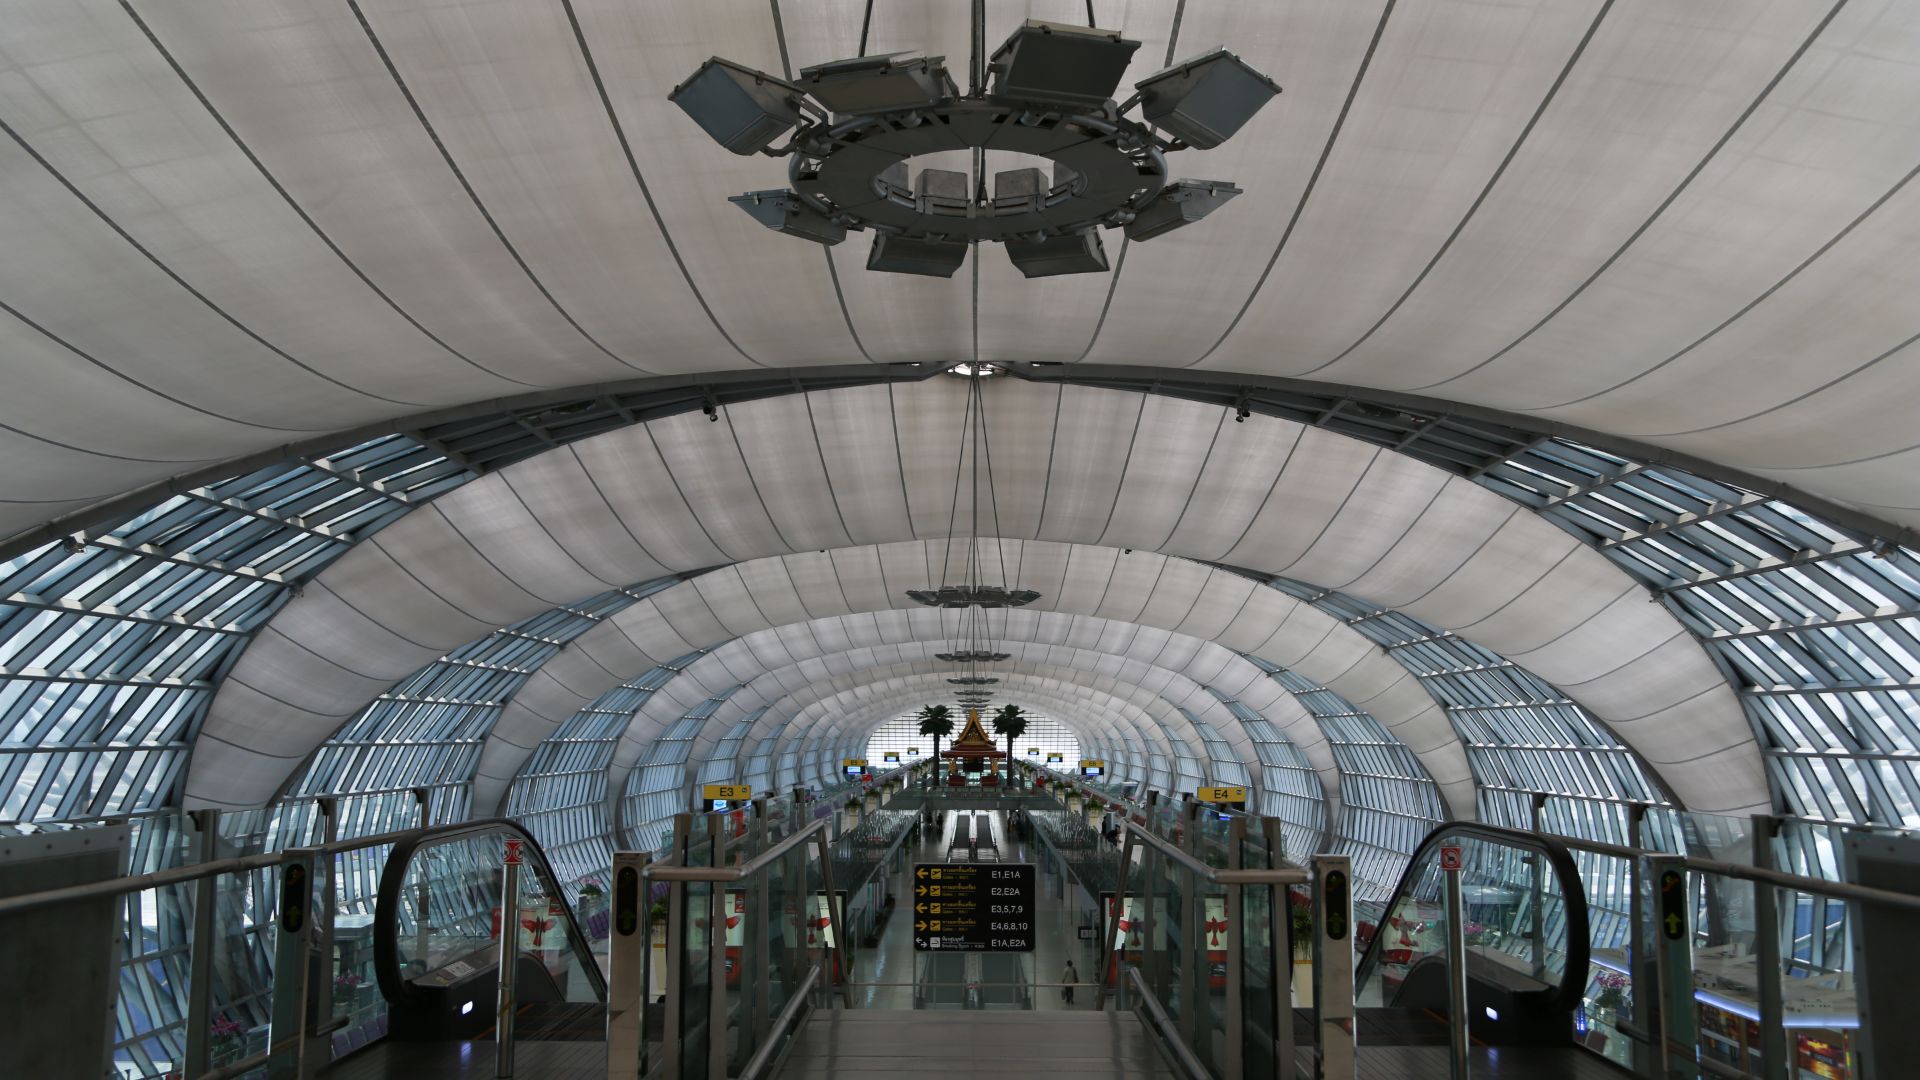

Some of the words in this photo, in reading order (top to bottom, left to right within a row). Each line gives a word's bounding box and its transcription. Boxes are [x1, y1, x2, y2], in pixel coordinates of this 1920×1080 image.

[720, 787, 733, 796] E3
[1214, 790, 1228, 798] E4
[991, 870, 1021, 880] E1,E1A
[991, 887, 1021, 897] E2,E2A
[991, 905, 1023, 914] E3,5,7,9
[991, 922, 1028, 931] E4,6,8,10
[991, 939, 1027, 948] E1A,E2A
